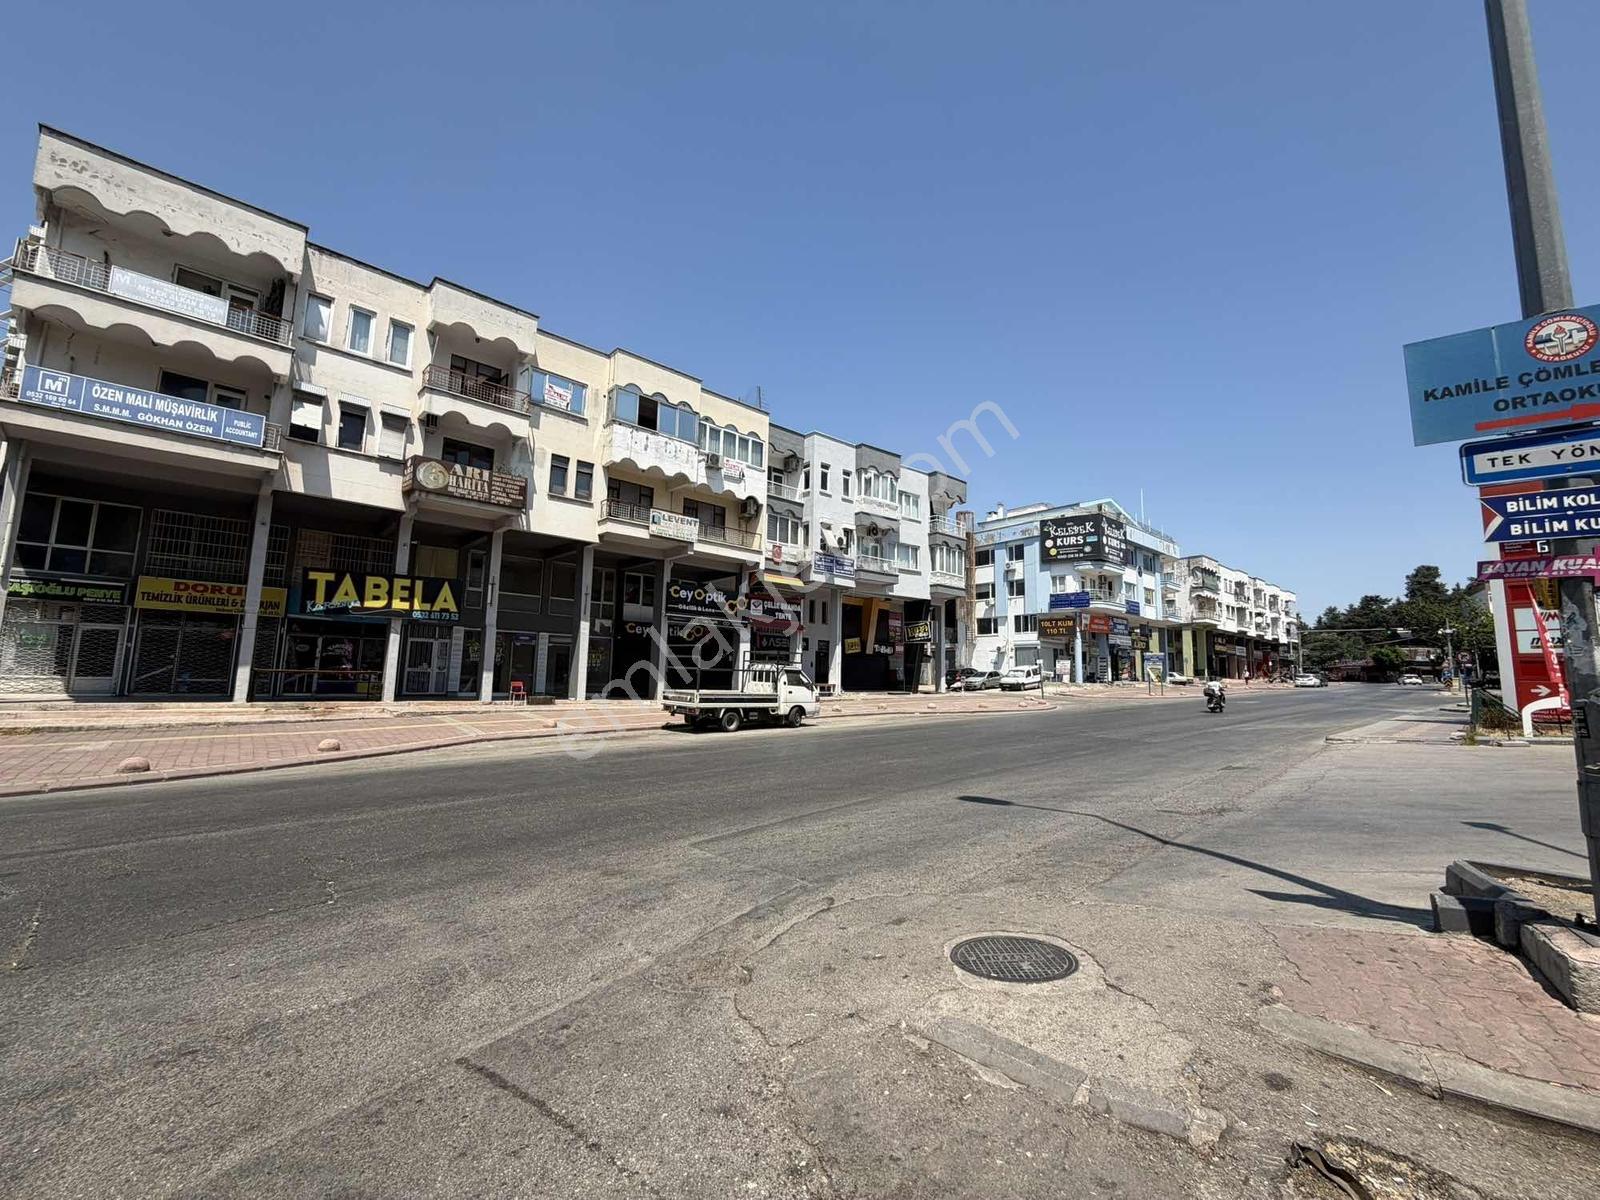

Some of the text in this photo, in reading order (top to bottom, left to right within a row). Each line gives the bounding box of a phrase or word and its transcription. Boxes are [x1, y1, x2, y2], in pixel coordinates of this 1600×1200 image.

[1423, 360, 1600, 401] KAMİLE ÇÖMLE
[92, 383, 218, 422] ÖZEN MALİ MÜŞAVİRLİK
[1493, 383, 1600, 412] ORTAOK
[94, 403, 213, 434] S.M.M.M. GÖKHAN ÖZEN
[225, 426, 258, 439] ACCOUNTANT
[1487, 453, 1532, 468] TEK
[1506, 493, 1600, 513] BİLİM KOL
[662, 513, 698, 527] LEVENT
[1510, 519, 1568, 536] BİLİM
[1049, 521, 1095, 538] KELEBEK
[1056, 536, 1084, 546] KURS
[1481, 560, 1546, 574] BAYAN
[1552, 558, 1600, 570] KUA
[173, 581, 247, 596] DORU
[308, 571, 459, 612] TABELA
[141, 591, 281, 610] TEMİZLİK ÜRÜNLERİ & DRJAN
